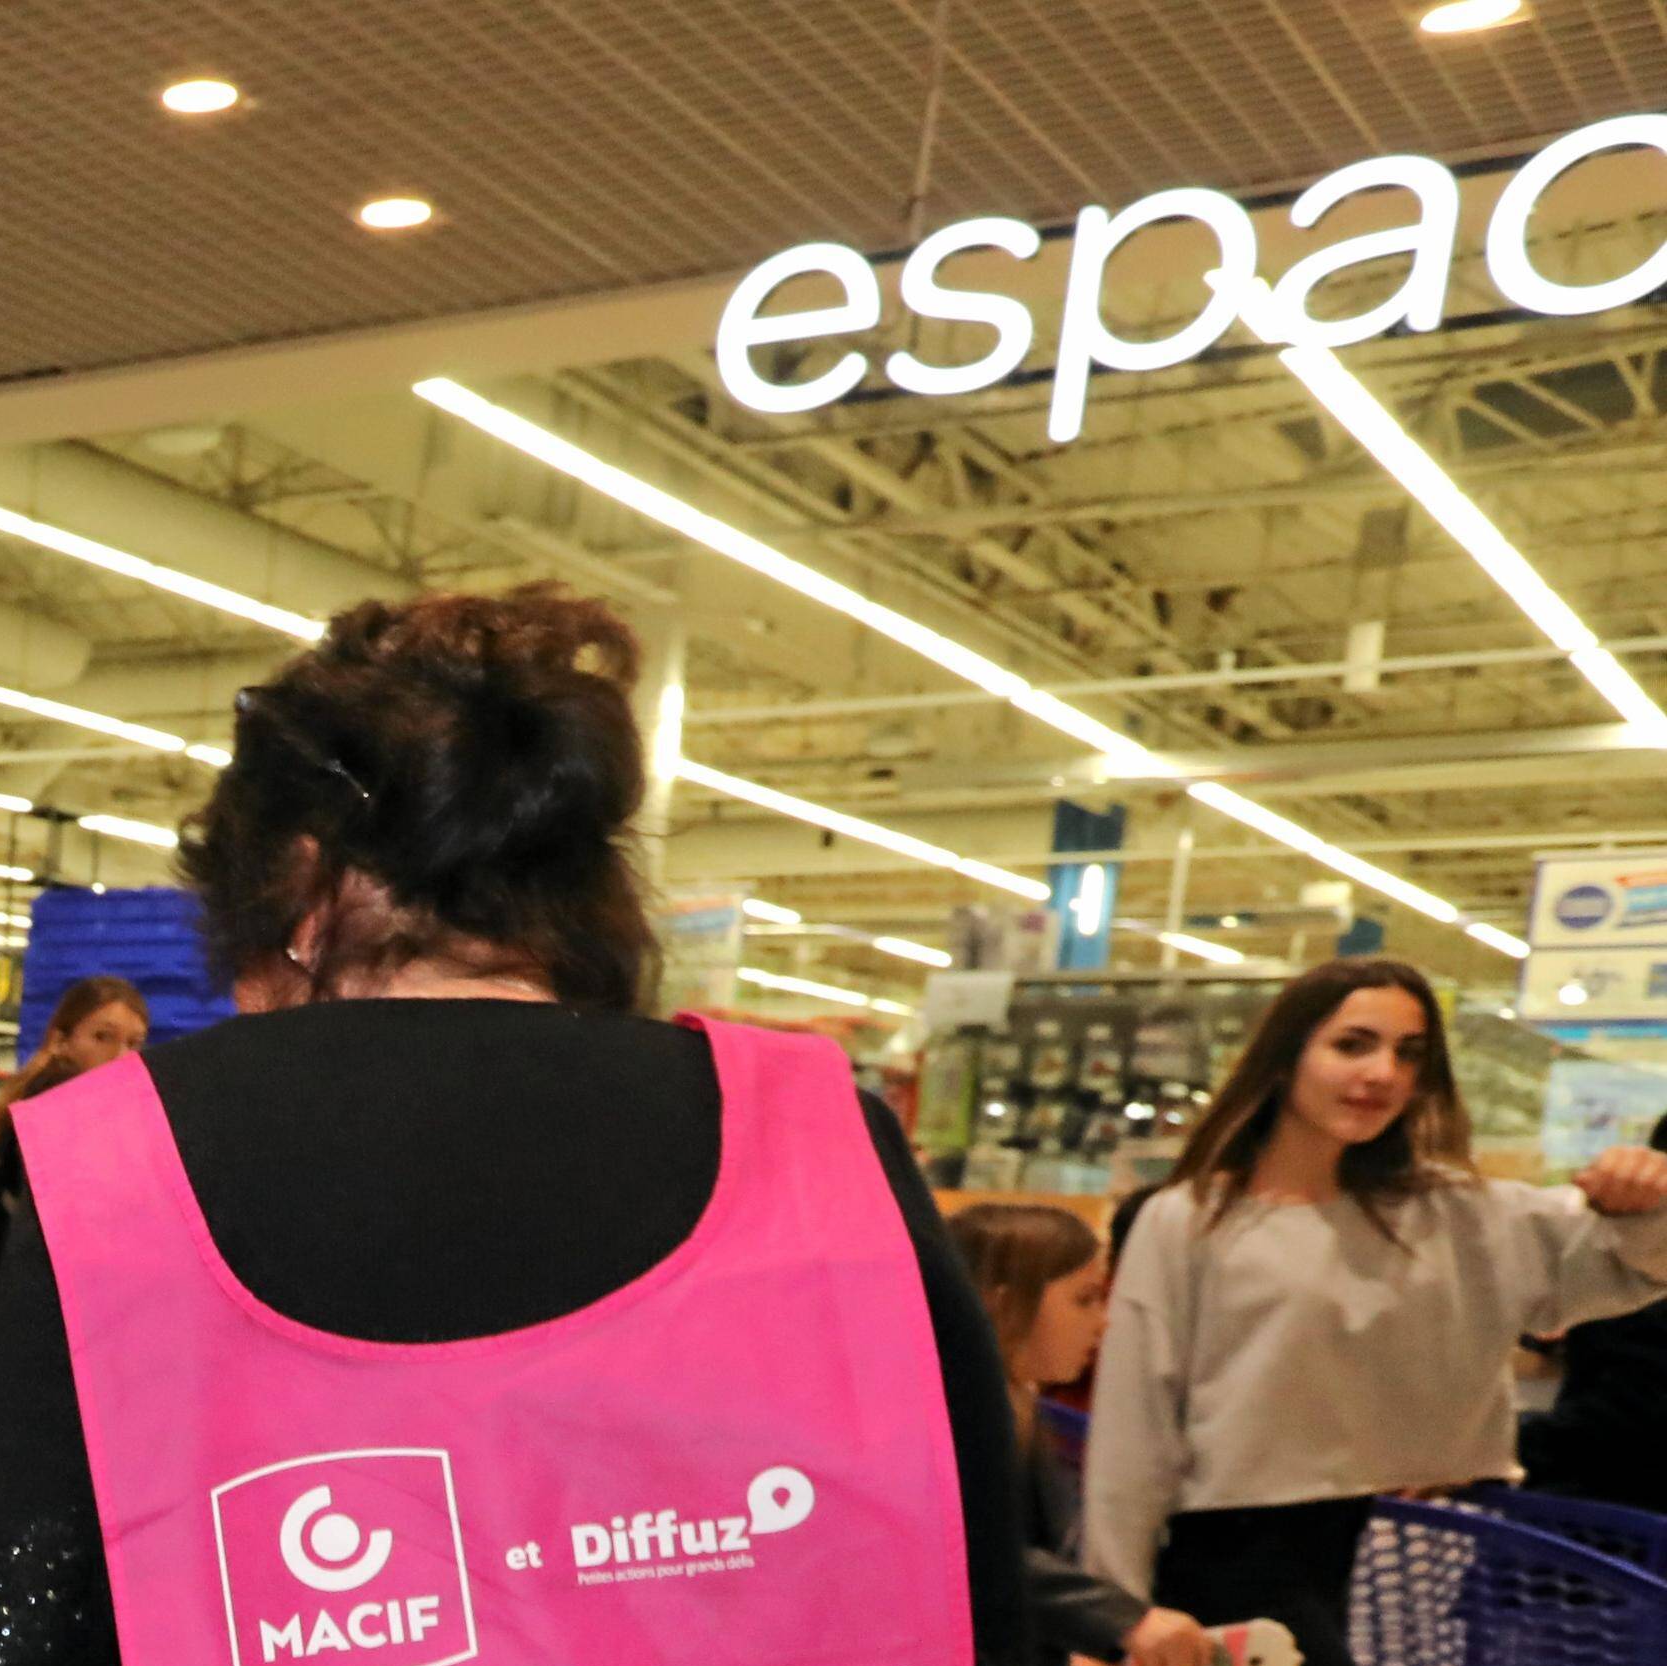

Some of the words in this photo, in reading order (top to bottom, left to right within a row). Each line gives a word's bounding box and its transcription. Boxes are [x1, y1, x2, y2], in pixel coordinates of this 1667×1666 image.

[258, 1595, 440, 1663] MACIF
[505, 1540, 544, 1571] et
[570, 1508, 751, 1568] Diffuz
[657, 1560, 684, 1581] pour
